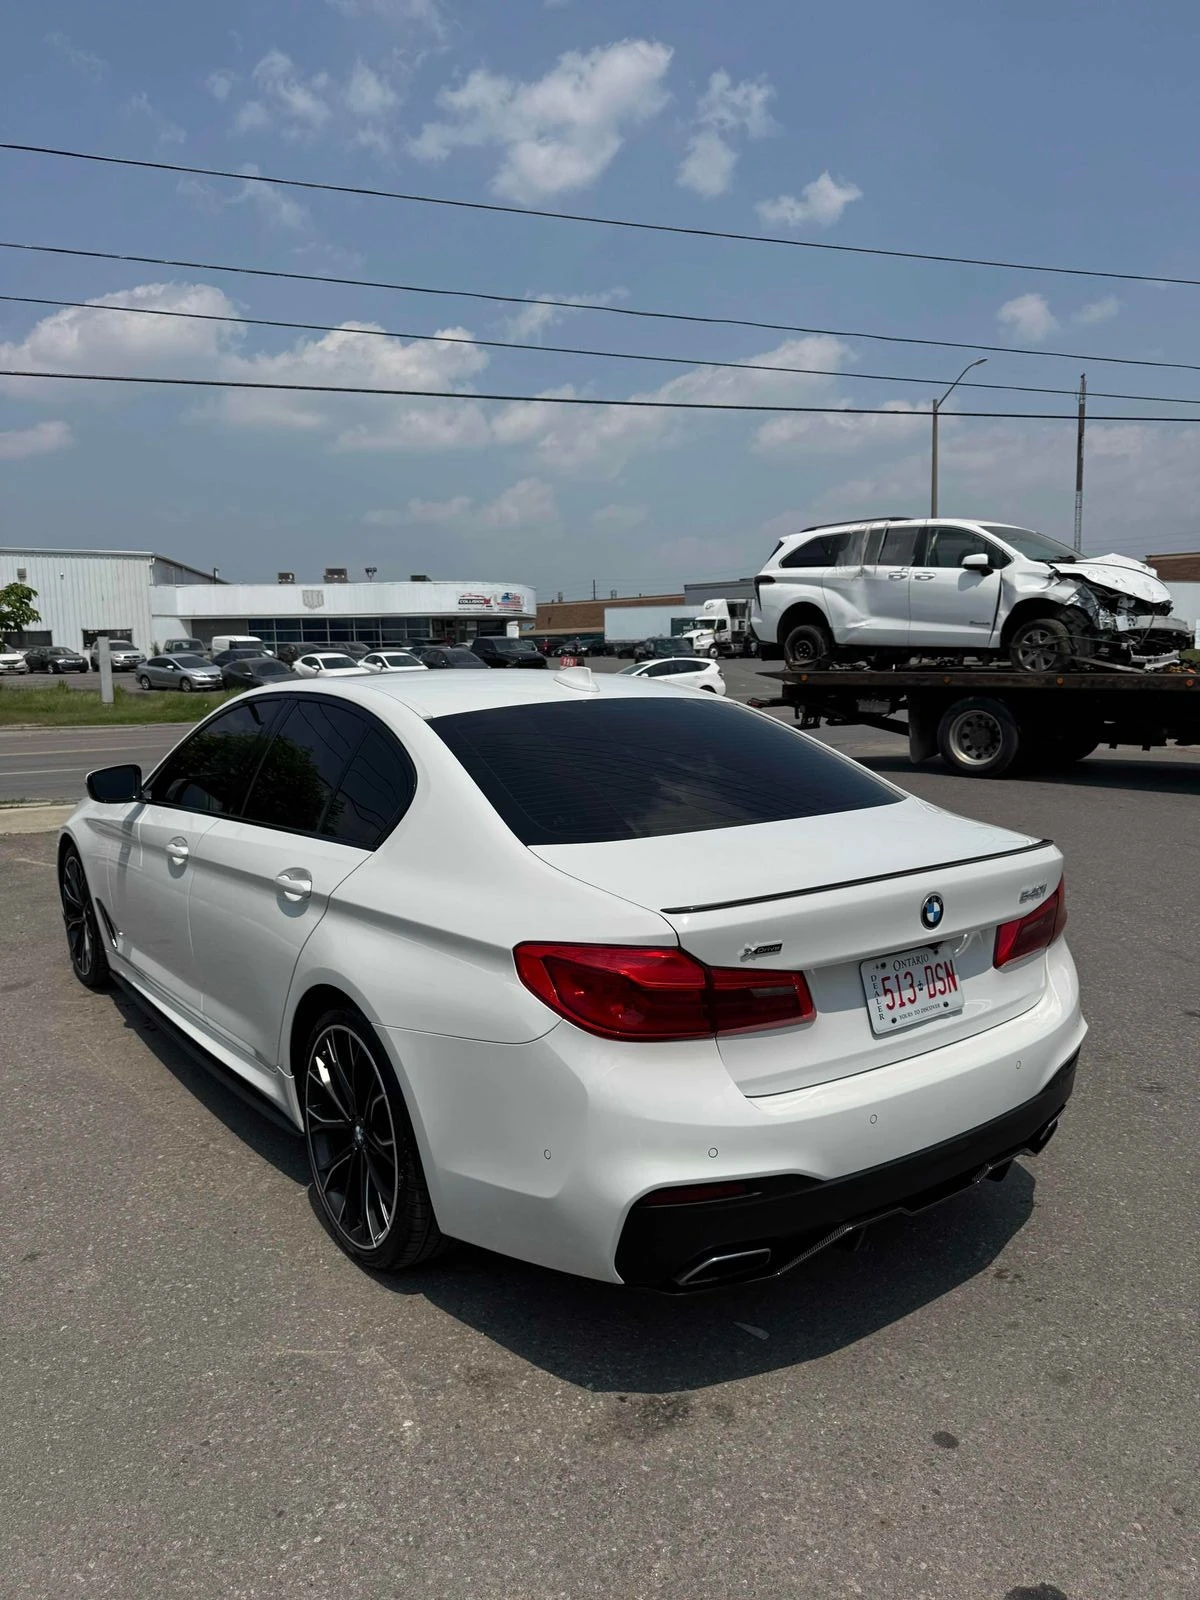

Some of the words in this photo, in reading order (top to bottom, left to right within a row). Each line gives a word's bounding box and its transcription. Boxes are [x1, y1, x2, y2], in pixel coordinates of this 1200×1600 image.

[871, 975, 885, 1020] DEALER
[881, 971, 917, 1010] 513
[924, 959, 958, 999] DSN
